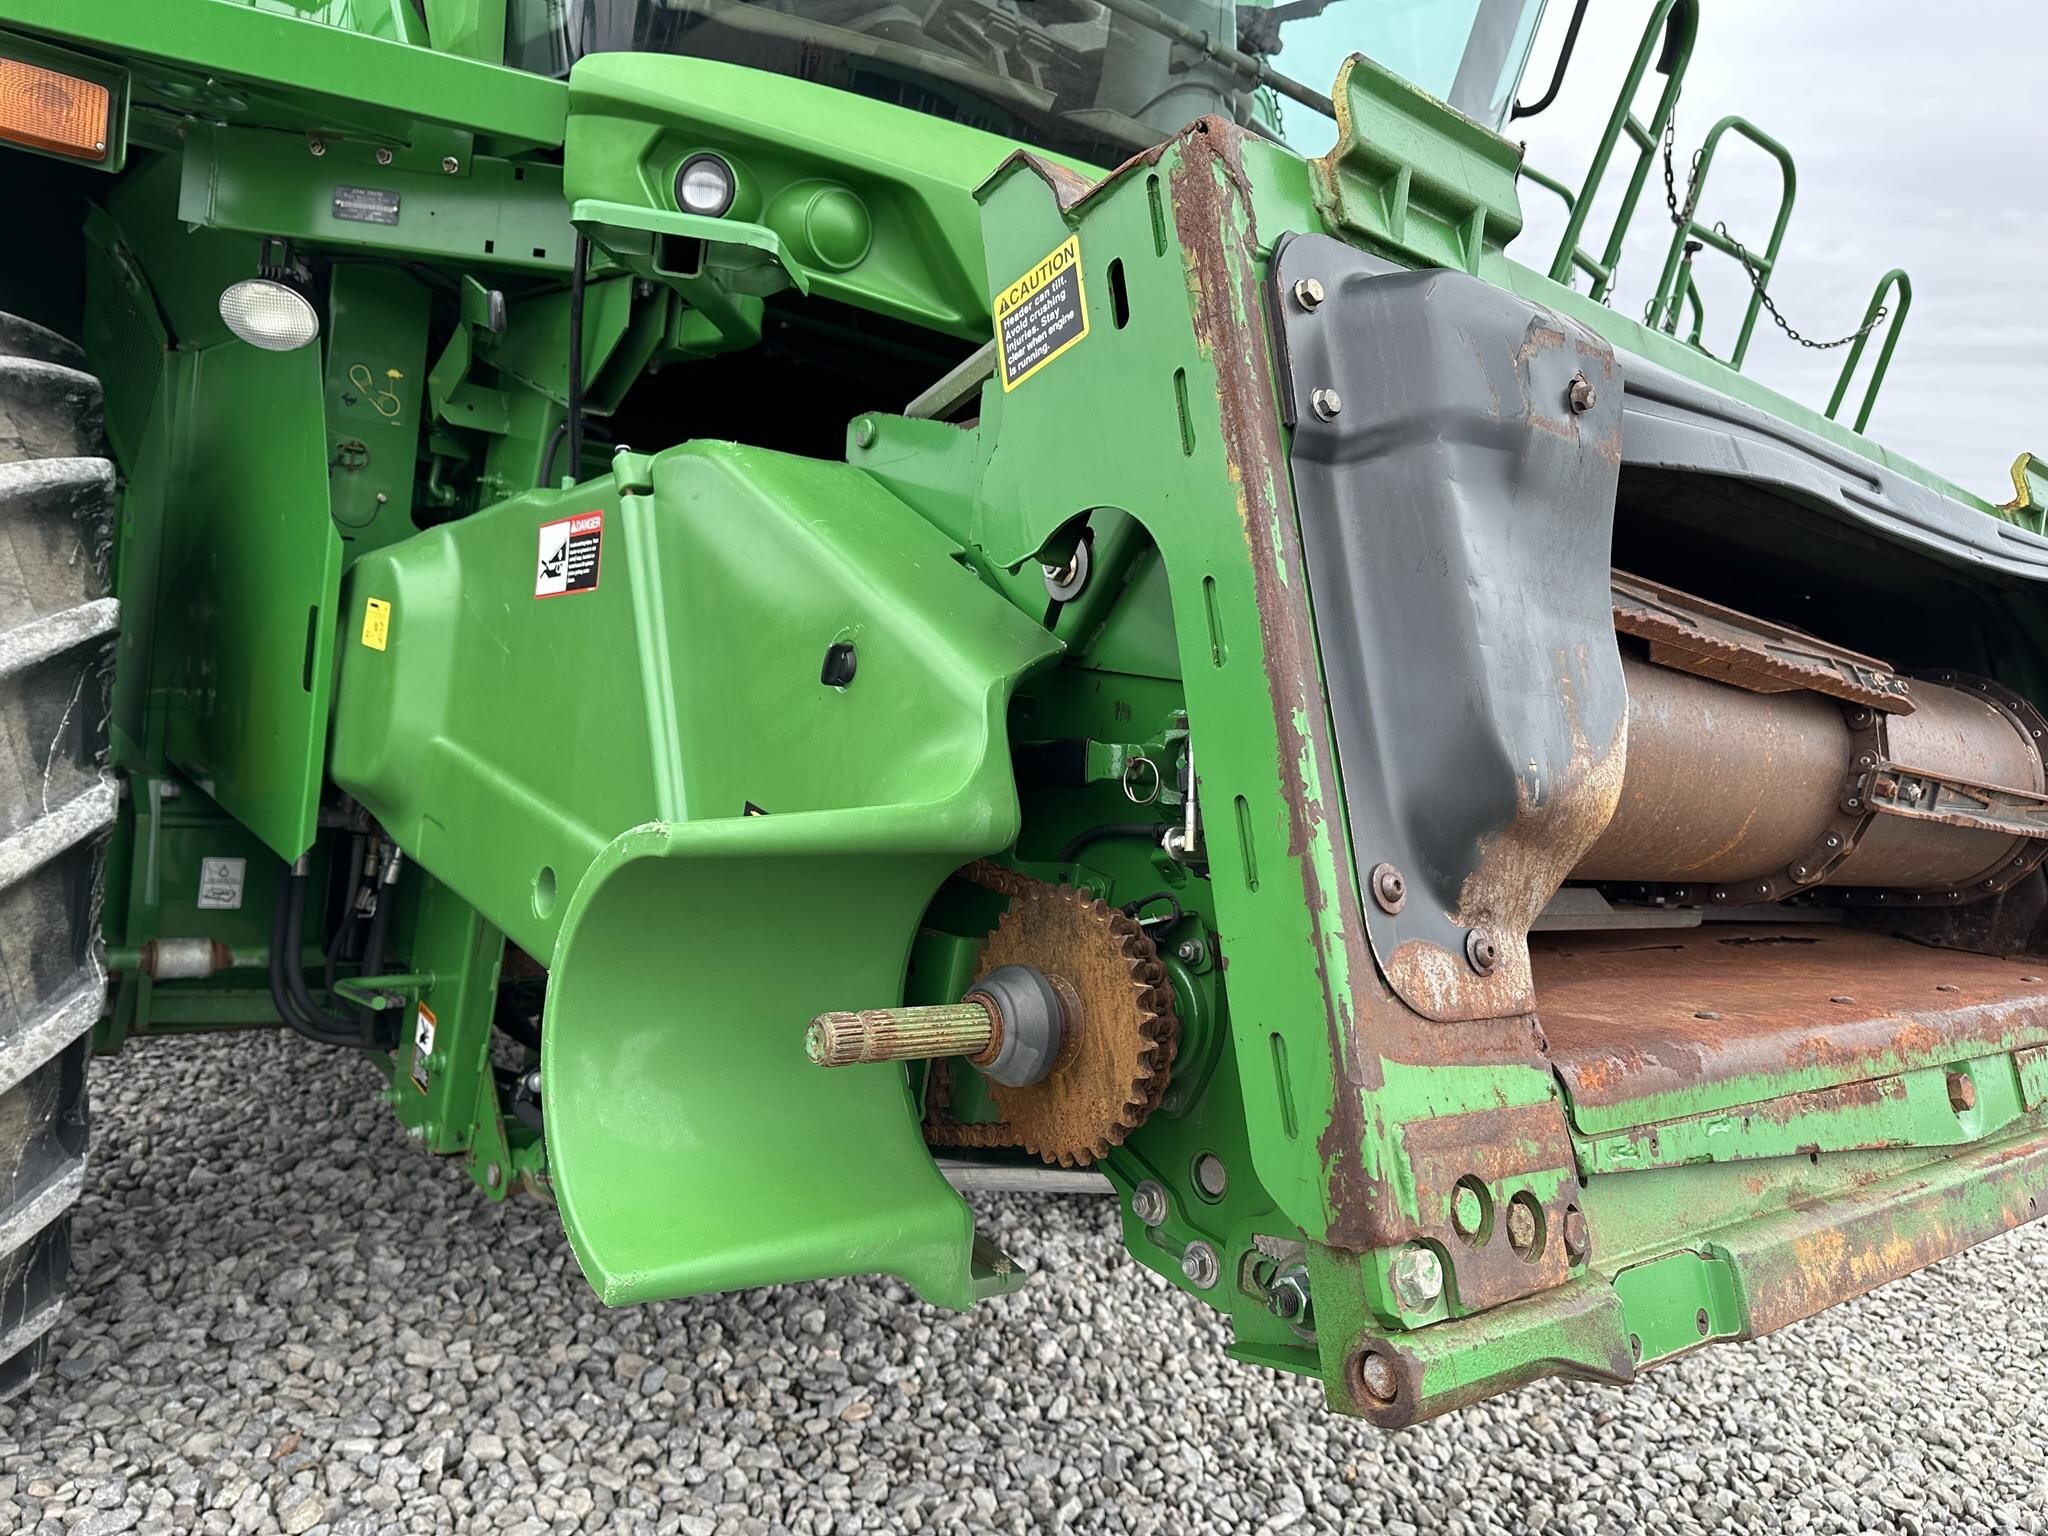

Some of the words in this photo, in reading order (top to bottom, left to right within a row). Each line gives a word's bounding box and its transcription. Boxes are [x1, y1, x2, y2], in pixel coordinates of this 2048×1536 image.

[1009, 243, 1074, 305] CAUTION
[1003, 300, 1032, 330] Header
[1034, 289, 1050, 309] can
[1051, 275, 1067, 294] tilt.
[1005, 316, 1028, 342] Avoid
[1029, 289, 1066, 322] crushing
[1006, 325, 1039, 354] injuries.
[1040, 307, 1060, 327] Stay
[1007, 347, 1026, 365] clear
[1026, 332, 1047, 352] when
[1048, 310, 1075, 335] engine
[1008, 366, 1017, 377] is
[1017, 344, 1050, 371] running.
[576, 516, 601, 530] DANGER
